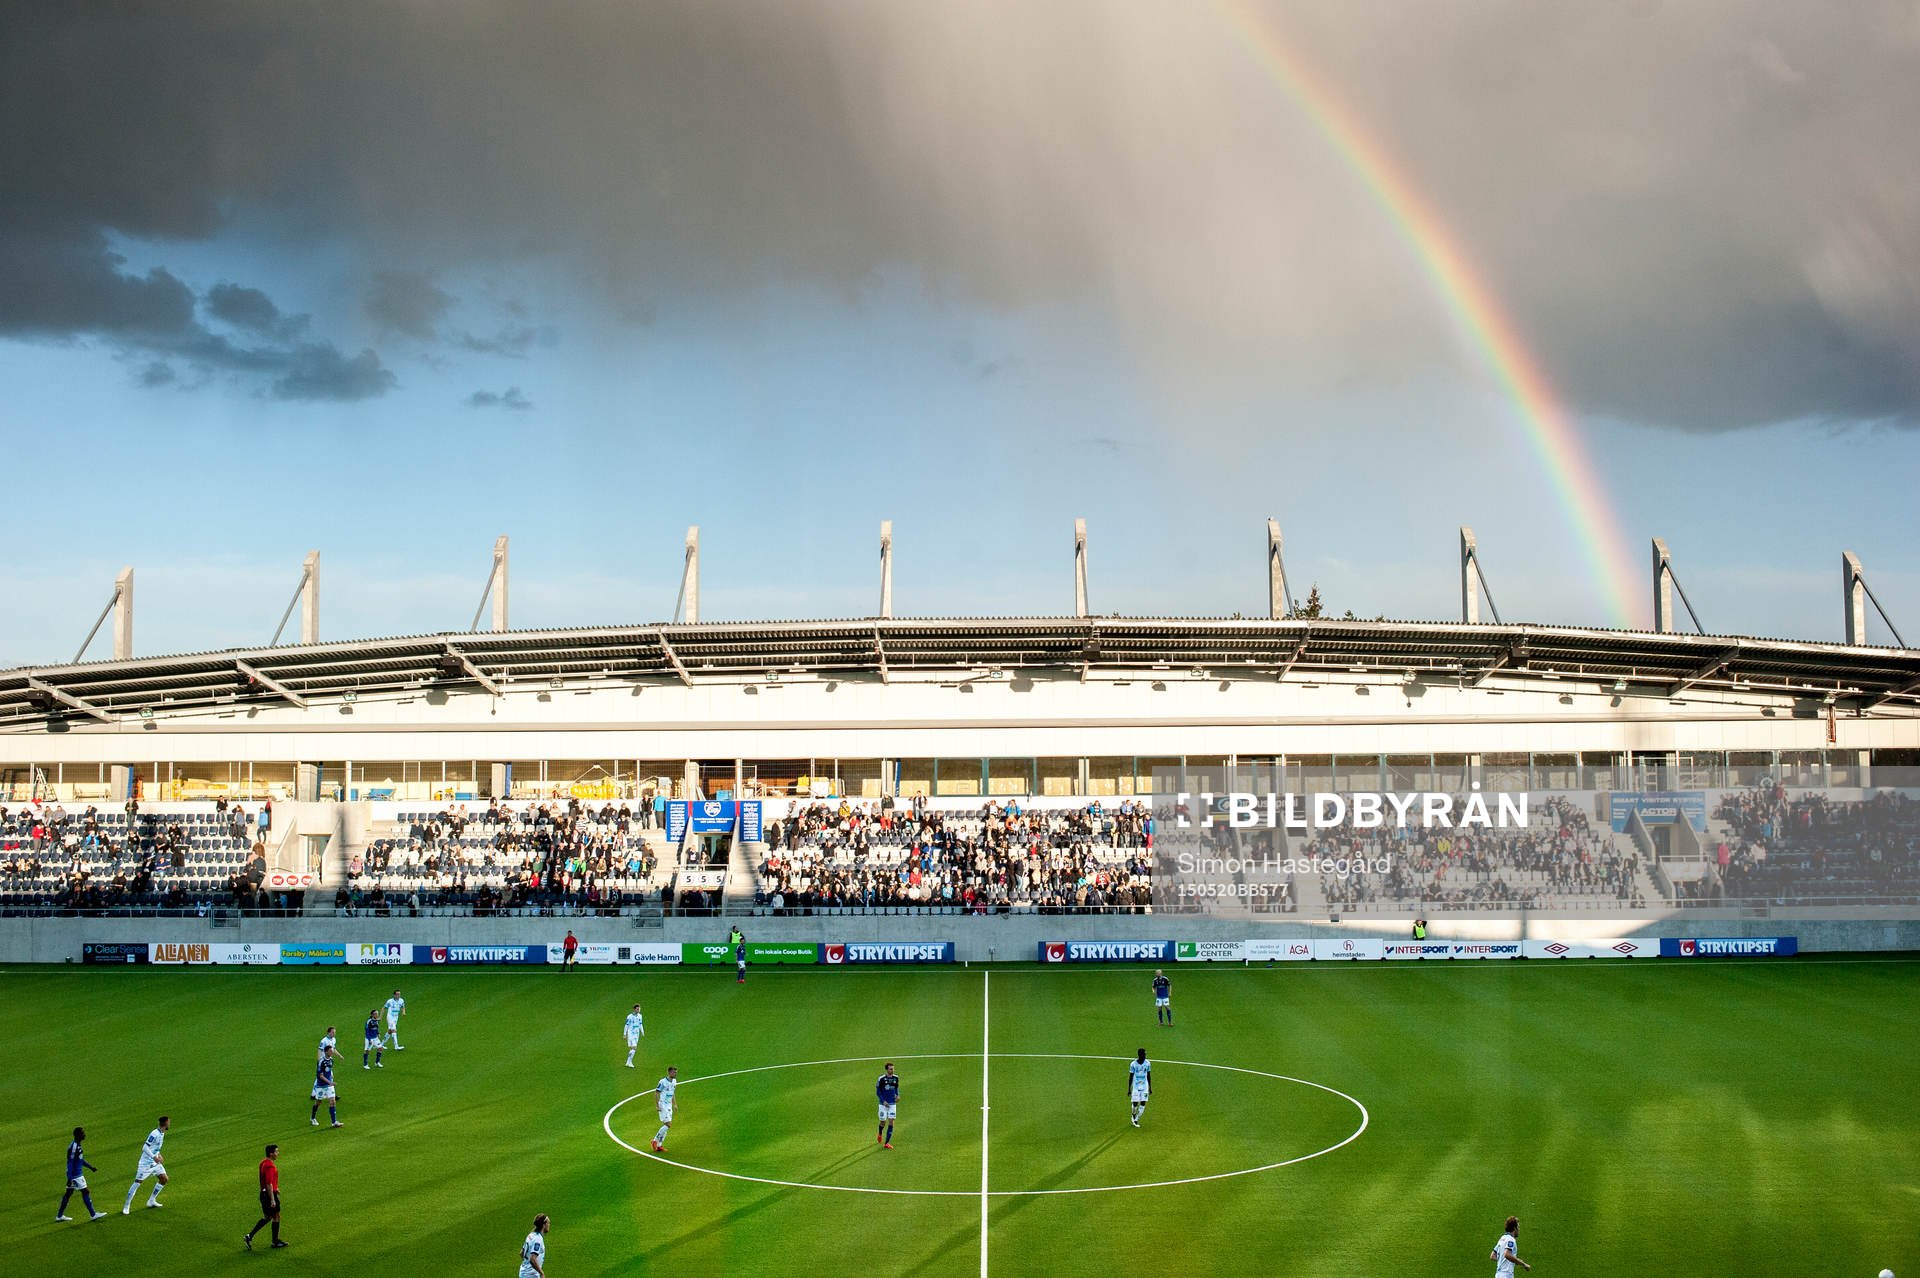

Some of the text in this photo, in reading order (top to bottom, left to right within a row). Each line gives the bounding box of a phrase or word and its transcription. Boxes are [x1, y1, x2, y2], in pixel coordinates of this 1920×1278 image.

[1640, 808, 1677, 816] ACTOR
[703, 946, 729, 955] coop
[1070, 943, 1166, 959] STRYKTIPSET
[1289, 944, 1310, 955] AGA
[1395, 945, 1450, 954] INTERSPORT
[1464, 945, 1518, 953] INTERSPORT
[1699, 940, 1777, 953] STRYKTIPSET
[227, 953, 269, 961] ABERSTEN
[450, 948, 526, 961] STRYKTIPSET
[634, 953, 656, 961] Gävle
[849, 945, 945, 960] STRYKTIPSET
